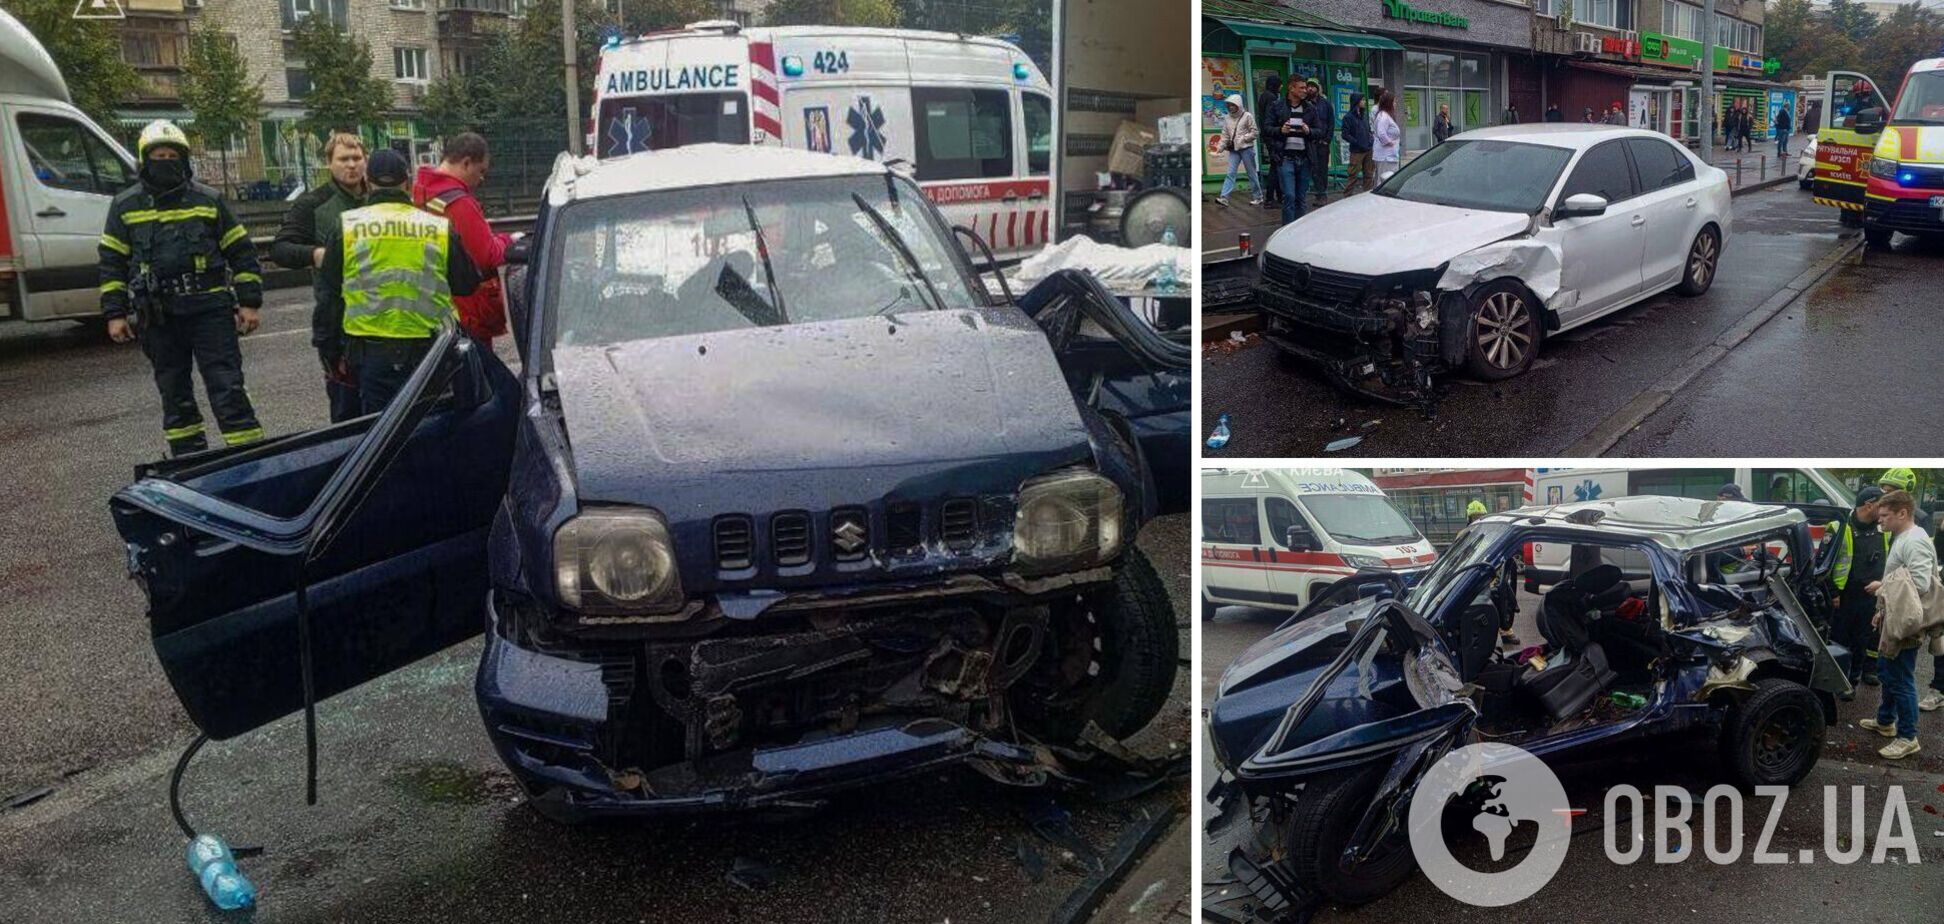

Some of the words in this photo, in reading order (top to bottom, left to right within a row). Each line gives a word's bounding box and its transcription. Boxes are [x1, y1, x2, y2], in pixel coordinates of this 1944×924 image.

[813, 50, 850, 74] 424
[606, 64, 739, 94] AMBULANCE
[937, 184, 991, 203] ДОПОМОГА
[353, 220, 438, 239] ПОЛІЦІЯ
